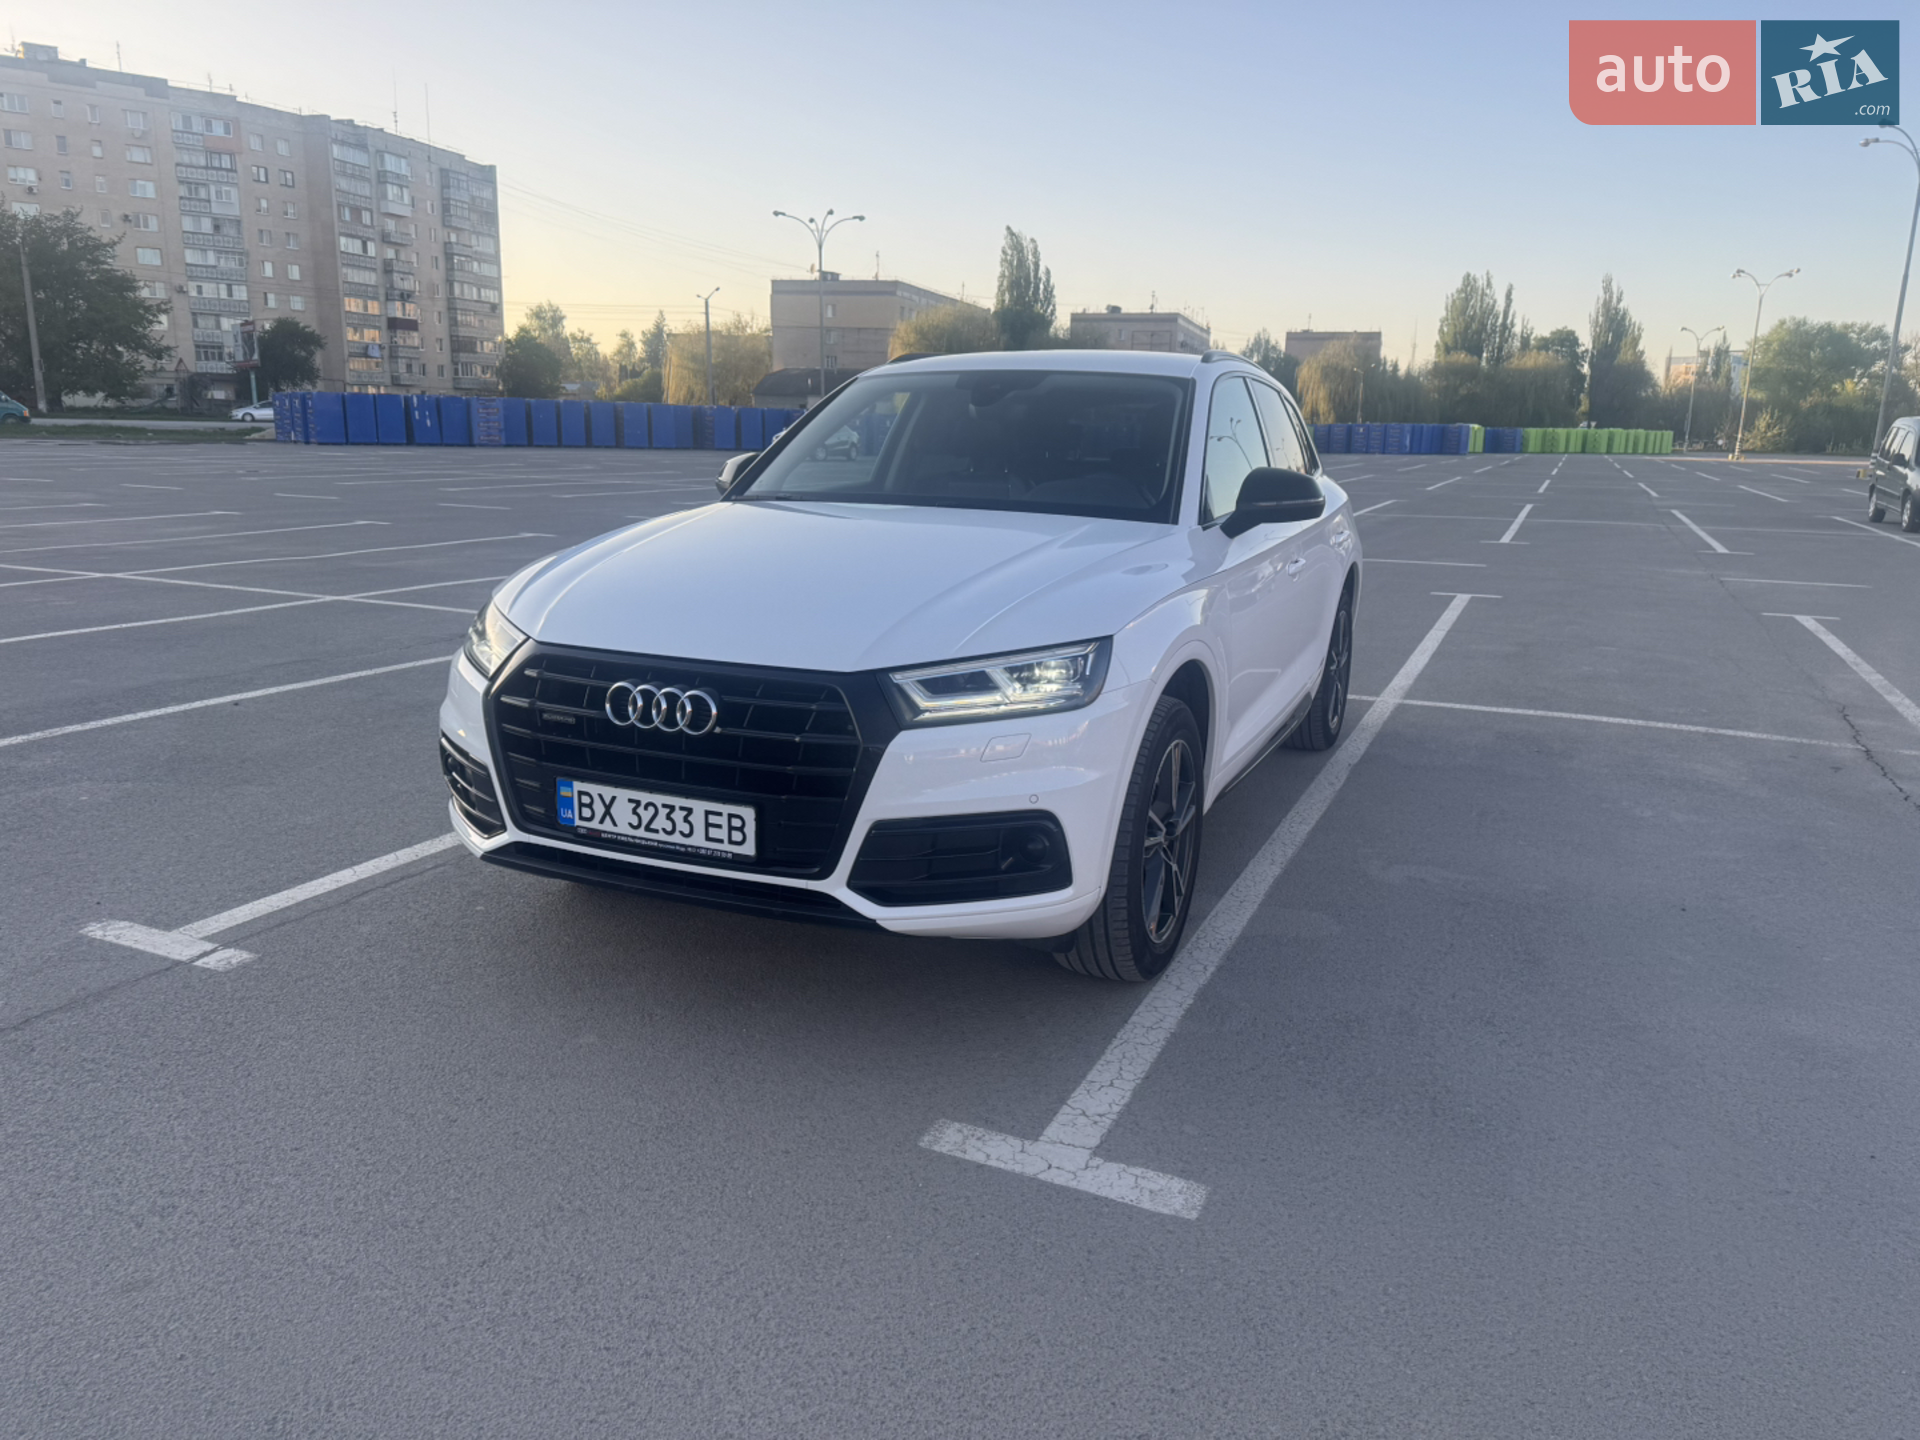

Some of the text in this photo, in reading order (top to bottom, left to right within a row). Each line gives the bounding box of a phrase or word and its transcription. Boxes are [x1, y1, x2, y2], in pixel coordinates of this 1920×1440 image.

[560, 808, 574, 819] UA
[577, 790, 747, 846] BX 3233 EB
